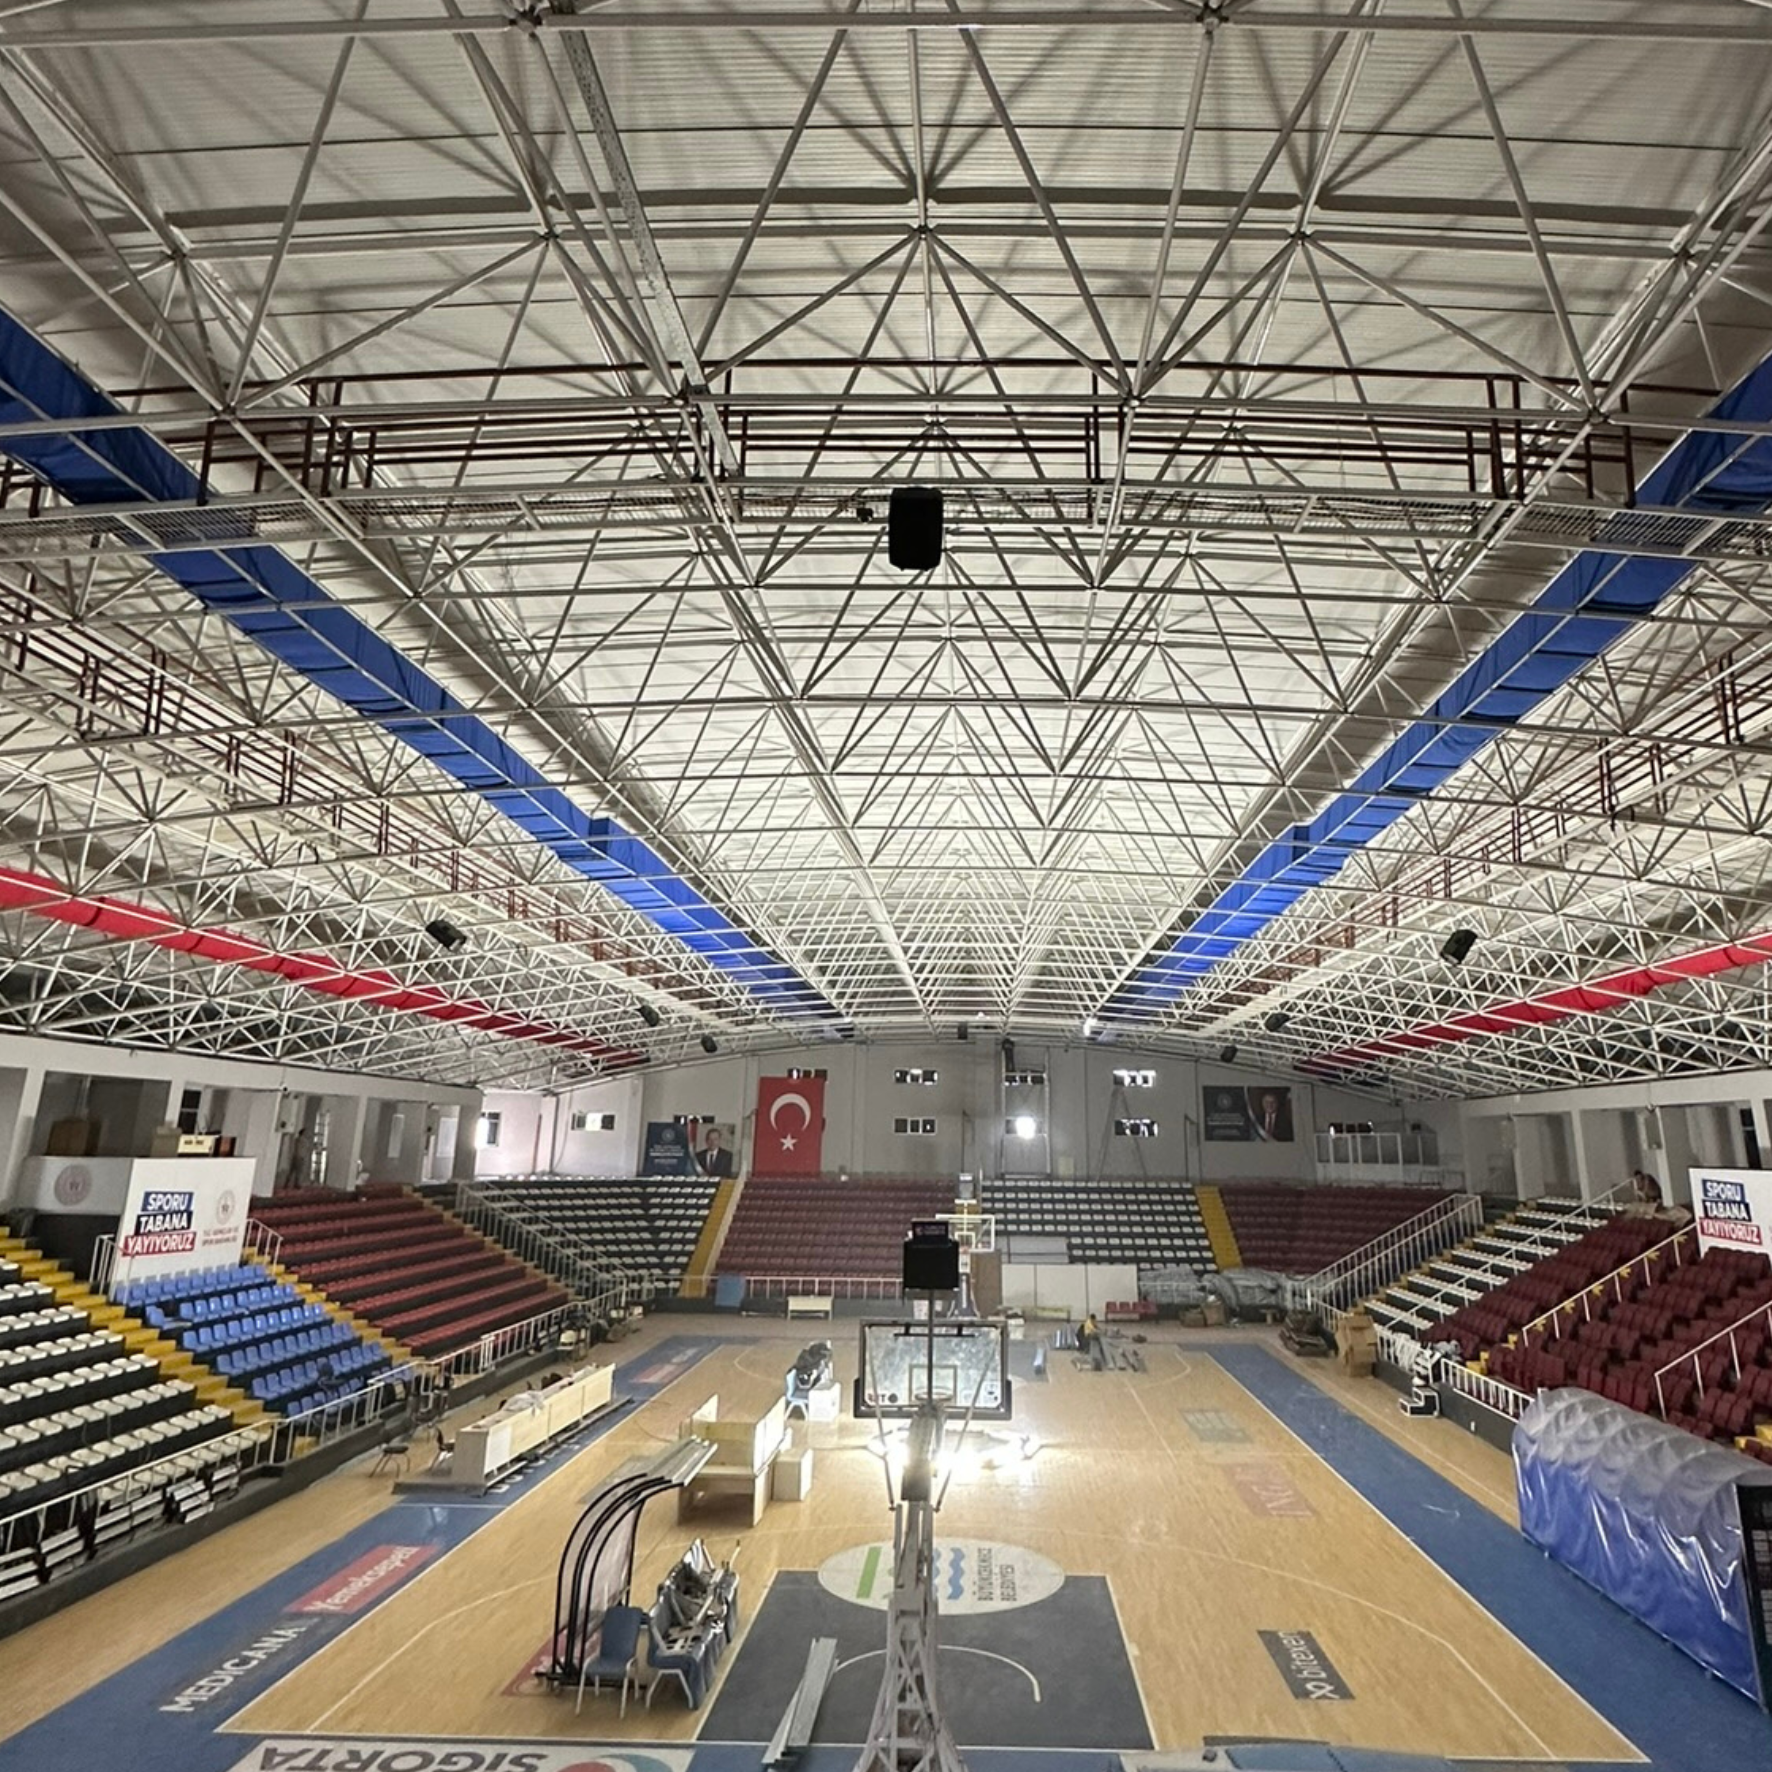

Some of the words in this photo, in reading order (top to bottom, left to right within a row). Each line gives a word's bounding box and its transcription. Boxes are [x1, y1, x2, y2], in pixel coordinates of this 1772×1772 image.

[1705, 1181, 1742, 1201] SPORU
[146, 1193, 190, 1211] SPORU
[1704, 1201, 1749, 1221] TABANA
[139, 1213, 189, 1233] TABANA
[1702, 1219, 1760, 1243] YAYIYORUZ
[126, 1233, 195, 1255] YAYIYORUZ
[1277, 1630, 1328, 1680] bitexen
[159, 1627, 307, 1713] MEDICANA
